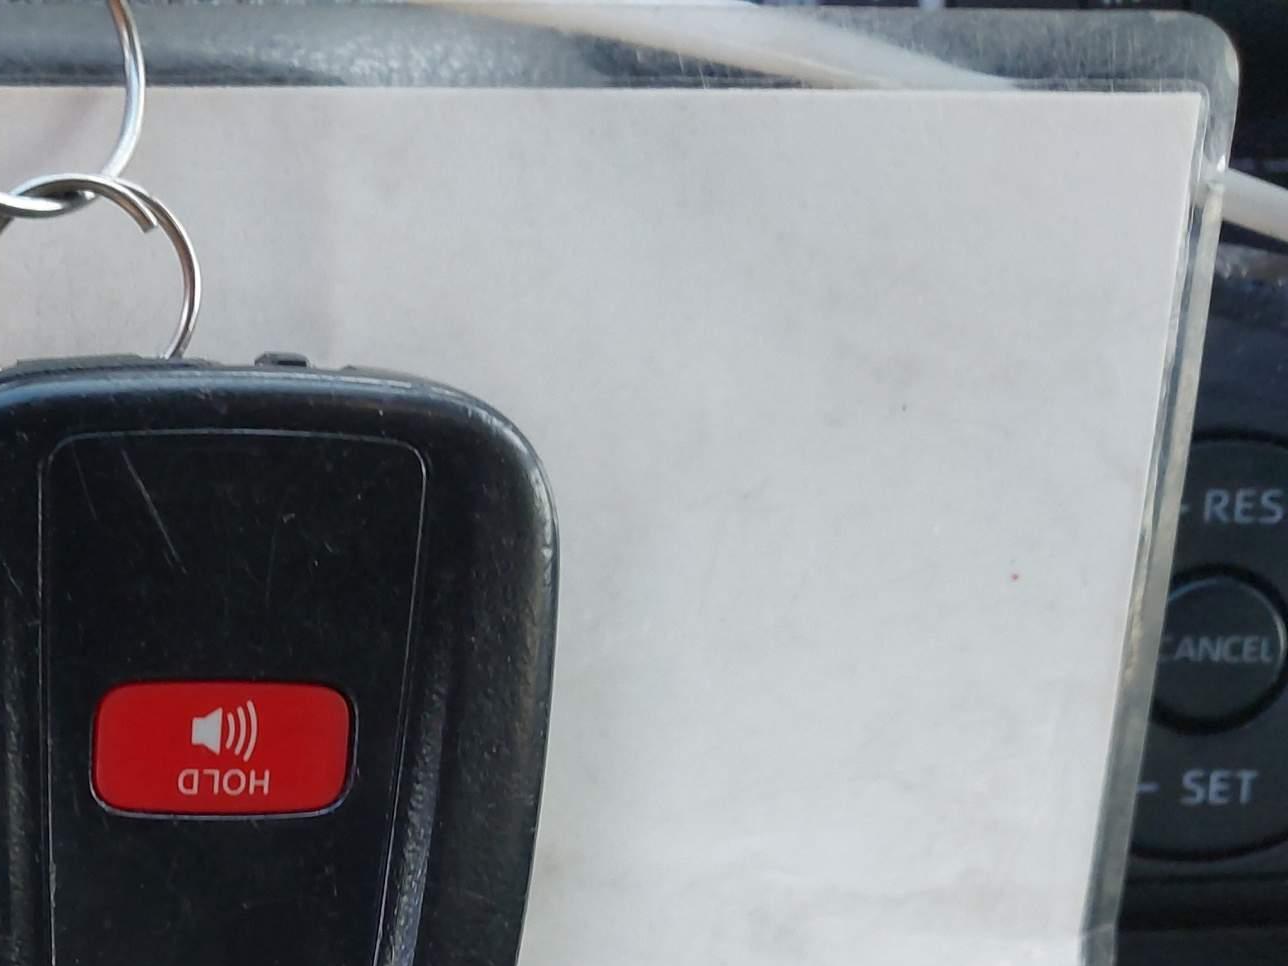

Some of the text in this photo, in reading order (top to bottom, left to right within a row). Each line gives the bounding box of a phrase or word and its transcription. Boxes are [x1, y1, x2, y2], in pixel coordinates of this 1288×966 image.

[1203, 487, 1285, 524] RES
[178, 769, 270, 795] HOLD
[1180, 768, 1258, 805] SET
